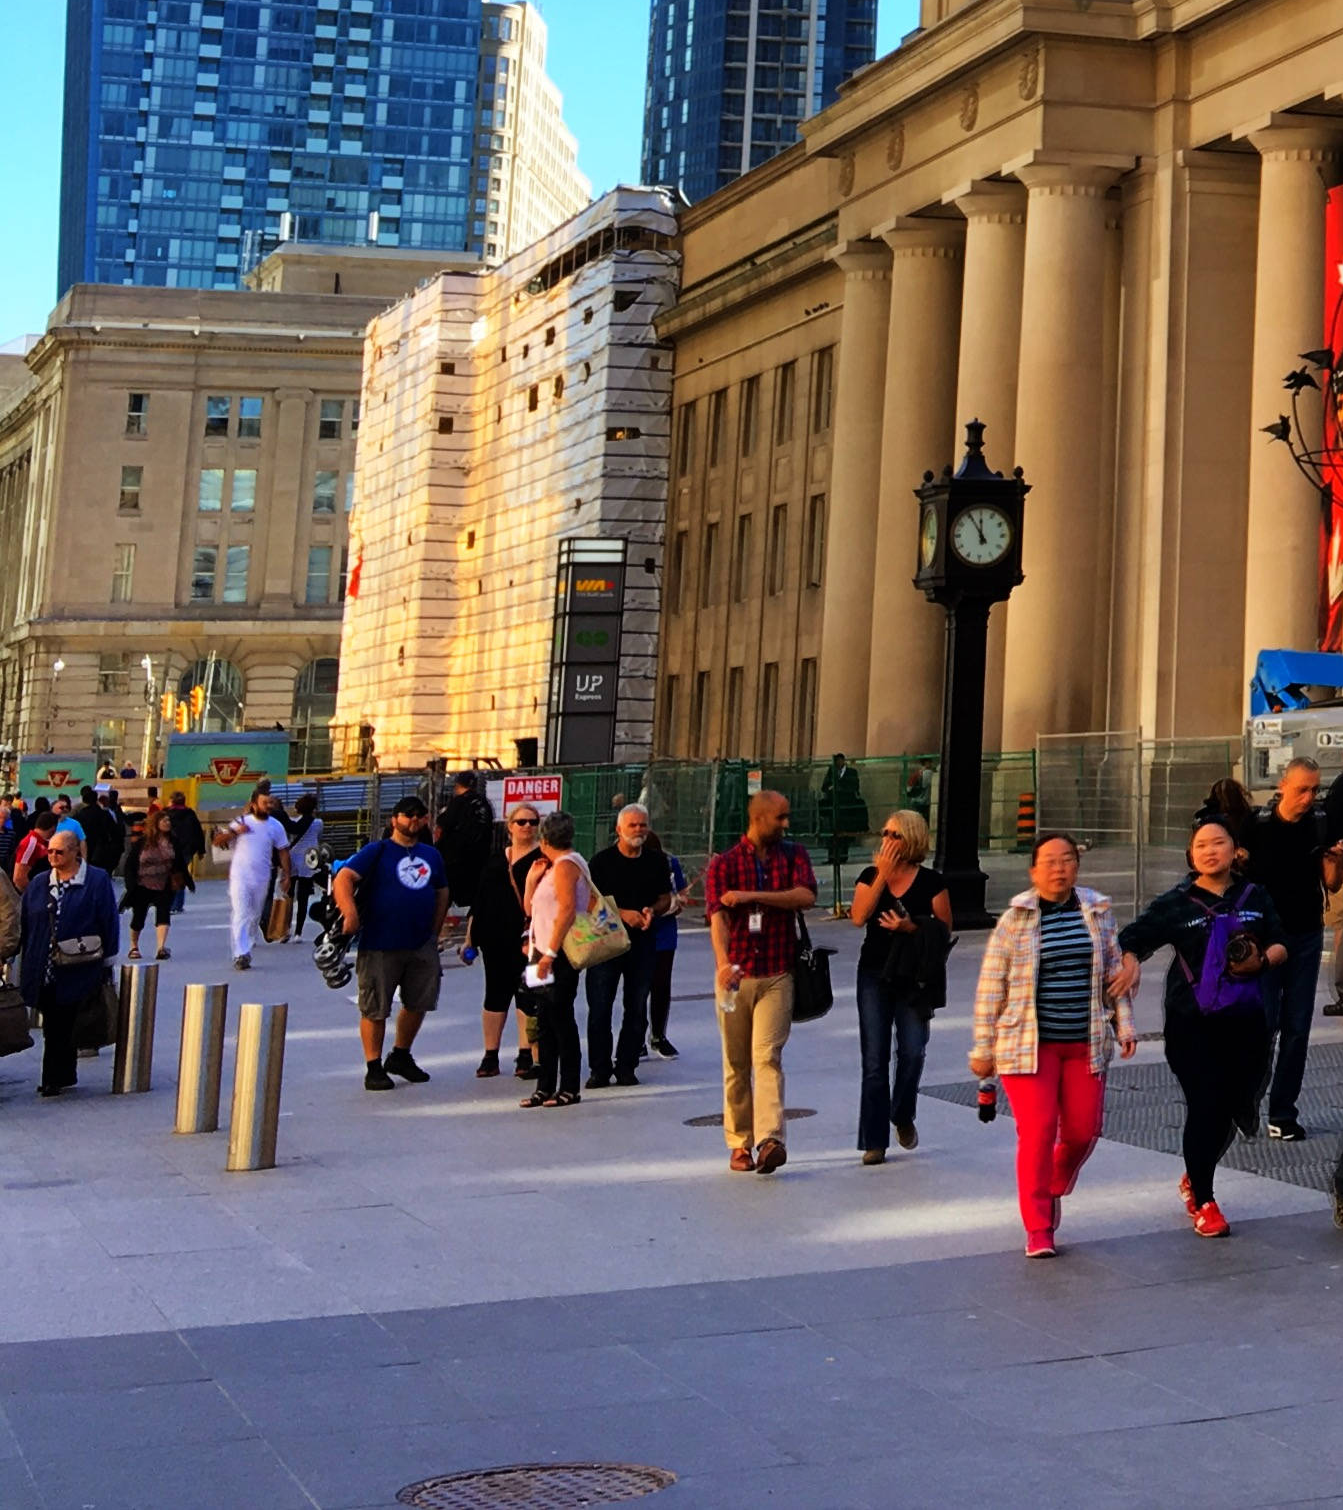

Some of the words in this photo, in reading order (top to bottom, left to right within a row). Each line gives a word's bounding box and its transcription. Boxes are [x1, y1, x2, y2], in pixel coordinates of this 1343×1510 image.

[576, 580, 606, 592] VIA
[576, 675, 603, 692] UP
[575, 693, 602, 702] Express
[507, 779, 559, 795] DANGER
